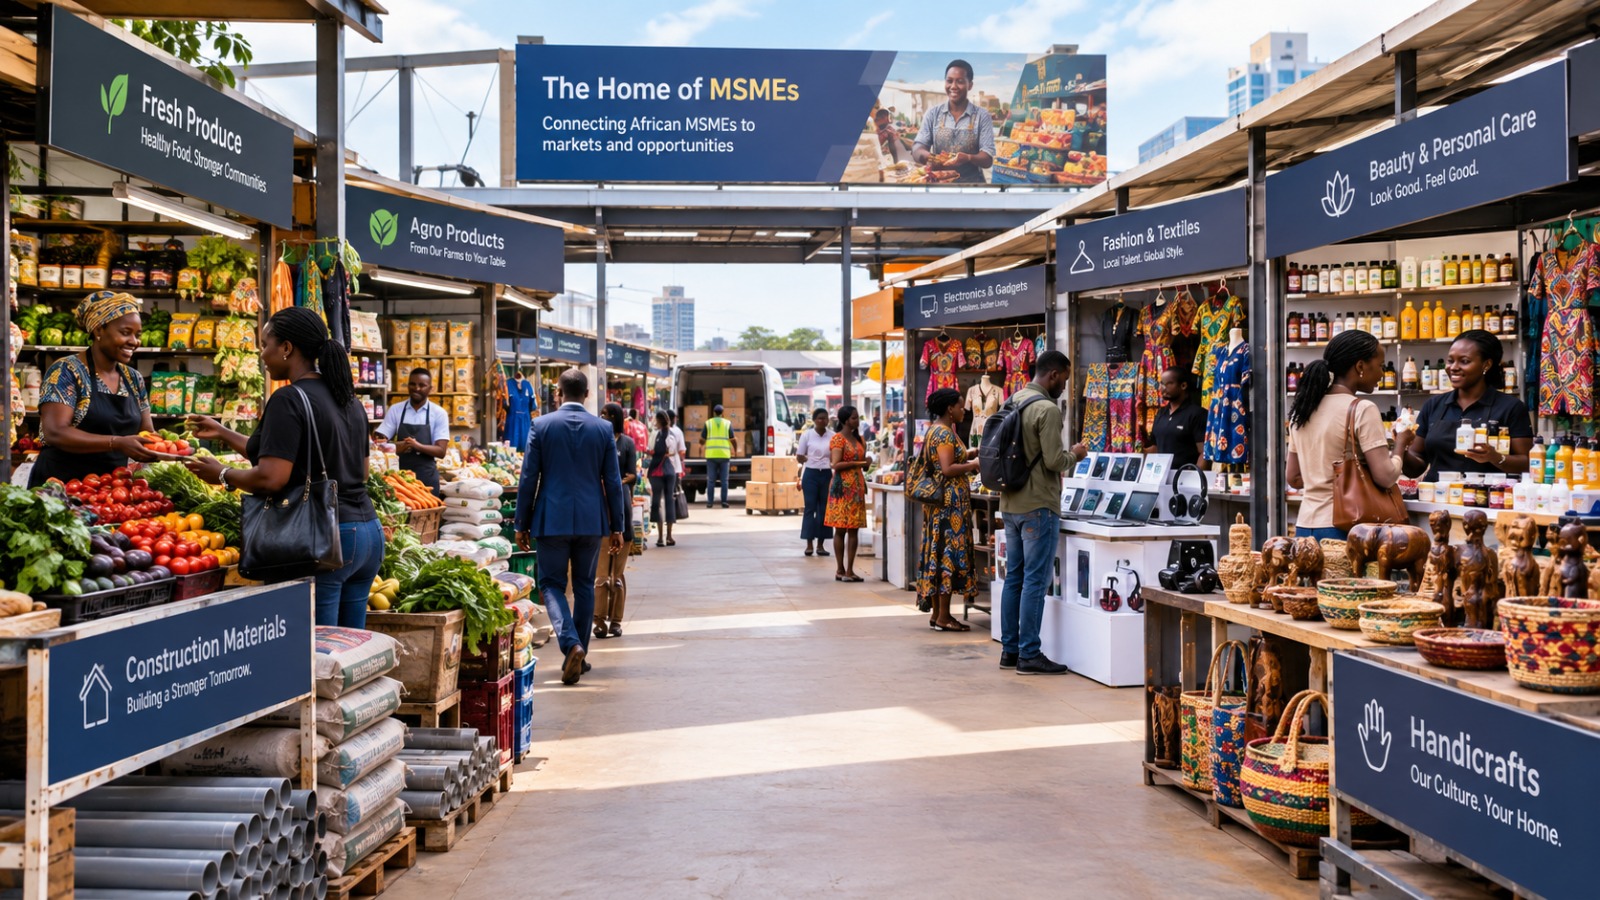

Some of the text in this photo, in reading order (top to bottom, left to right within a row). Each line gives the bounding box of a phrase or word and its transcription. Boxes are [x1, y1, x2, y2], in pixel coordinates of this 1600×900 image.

[542, 76, 799, 101] The Home of MSMEs
[142, 84, 242, 154] Fresh Produce
[542, 116, 756, 134] Connecting African MSMEs to
[141, 126, 268, 194] Healthy Food. Stronger Communities.
[542, 137, 734, 155] markets and opportunities
[1370, 109, 1537, 182] Beauty & Personal Care
[1370, 159, 1479, 207] Look Good. Feel Good.
[410, 216, 505, 250] Agro Products
[1103, 219, 1200, 252] Fashion & Textiles
[410, 242, 506, 267] From Our Farms to Your Table
[1103, 245, 1184, 269] Local Talent. Global Style.
[944, 281, 1028, 303] Electronics & Gadgets
[126, 614, 287, 683] Construction Materials
[127, 663, 252, 715] Building a Stronger Tomorrow.
[1411, 715, 1540, 797] Handicrafts
[1411, 764, 1562, 847] Our Culture. Your Home.
